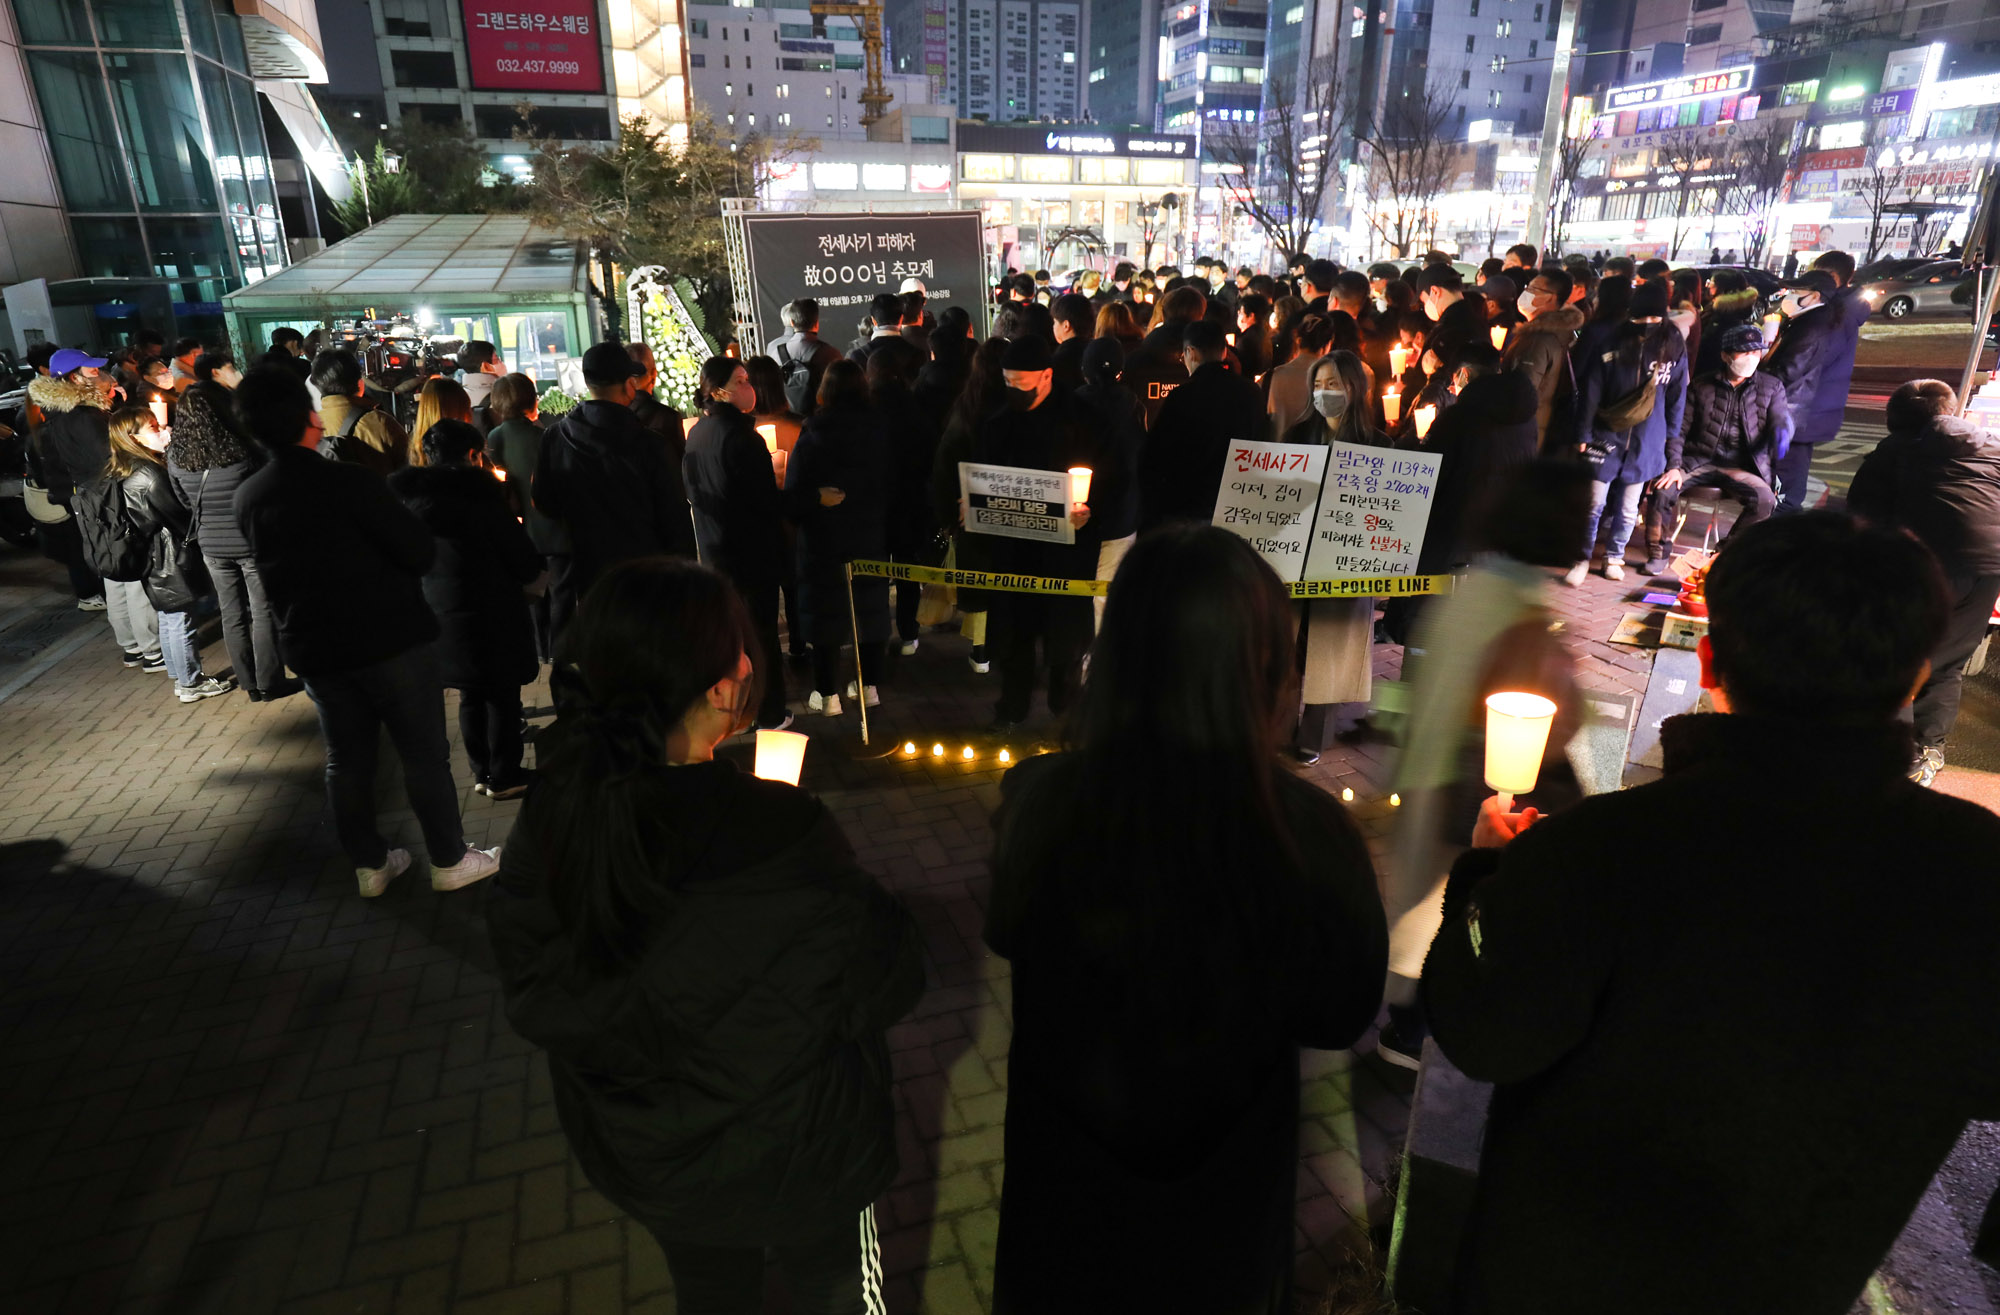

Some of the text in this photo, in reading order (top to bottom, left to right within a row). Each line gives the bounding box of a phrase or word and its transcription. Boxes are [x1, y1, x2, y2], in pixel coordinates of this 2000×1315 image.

[476, 12, 590, 34] 그랜드하우스웨딩
[496, 58, 580, 74] 032.437.9999
[1826, 95, 1899, 116] 오드리 뷰티
[818, 232, 916, 257] 전세사기 피해자
[891, 259, 934, 281] 추모제
[850, 295, 863, 304] 오후
[864, 294, 875, 303] 7시
[1234, 448, 1310, 473] 전세사기
[1336, 450, 1385, 477] 빌라왕
[1231, 482, 1302, 502] 이제, 집이
[1333, 473, 1379, 494] 건축왕
[986, 497, 1048, 515] 남모씨 일당
[1340, 493, 1403, 512] 대한민국은
[978, 509, 1057, 532] 엄중처벌하라!
[1224, 505, 1302, 526] 감옥이 되었고
[1324, 509, 1396, 532] 그들을 왕으로
[1256, 537, 1302, 555] 되었어요
[1321, 530, 1414, 555] 피해자는 신불자로
[886, 565, 911, 578] LINE
[1335, 555, 1410, 574] 만들었습니다
[1042, 579, 1070, 591] LINE
[1399, 578, 1431, 592] LINE
